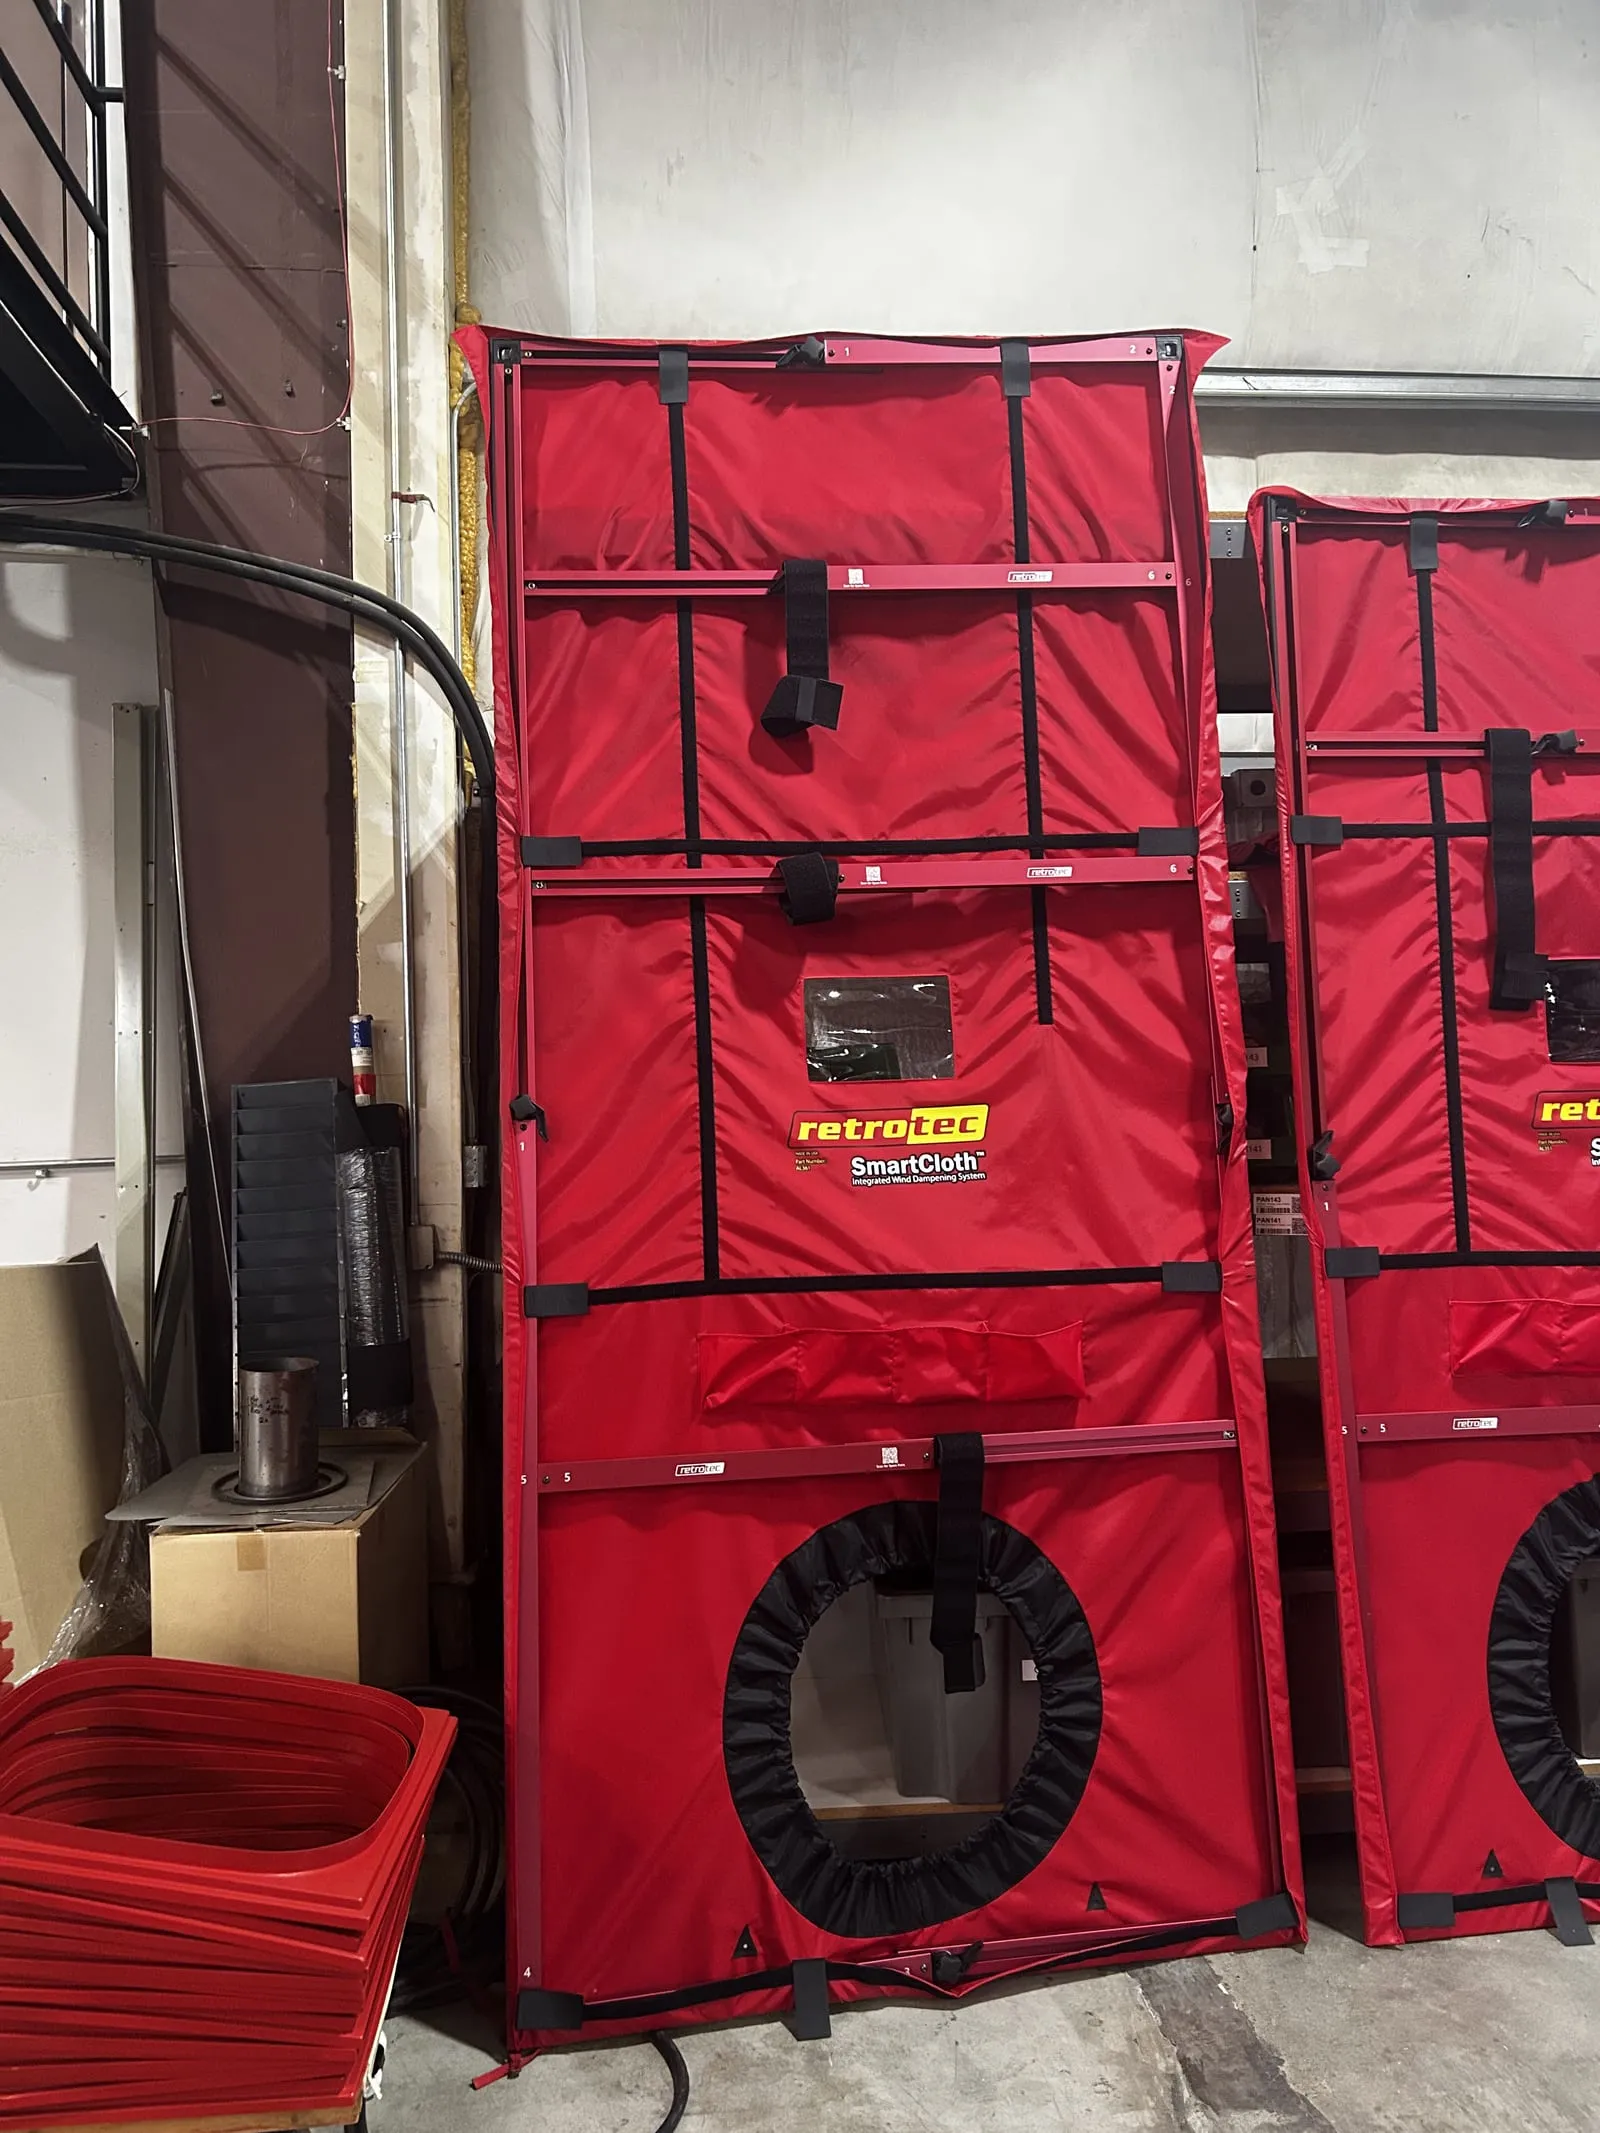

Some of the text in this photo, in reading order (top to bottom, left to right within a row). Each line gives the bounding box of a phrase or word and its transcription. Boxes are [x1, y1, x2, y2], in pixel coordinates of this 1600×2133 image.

[844, 346, 850, 357] 1
[1129, 344, 1137, 354] 2
[1168, 385, 1176, 395] 2
[1010, 572, 1051, 581] retro
[1148, 570, 1155, 580] 6
[1185, 578, 1192, 586] 6
[1170, 863, 1177, 873] 6
[797, 1113, 980, 1142] retrotec
[519, 1141, 525, 1151] 1
[852, 1171, 986, 1187] Integrated Wind Dampening System
[1323, 1201, 1329, 1211] 1
[1341, 1425, 1348, 1435] 5
[1380, 1423, 1386, 1433] 5
[521, 1474, 528, 1485] 5
[564, 1471, 571, 1483] 5
[523, 1966, 531, 1978] 4
